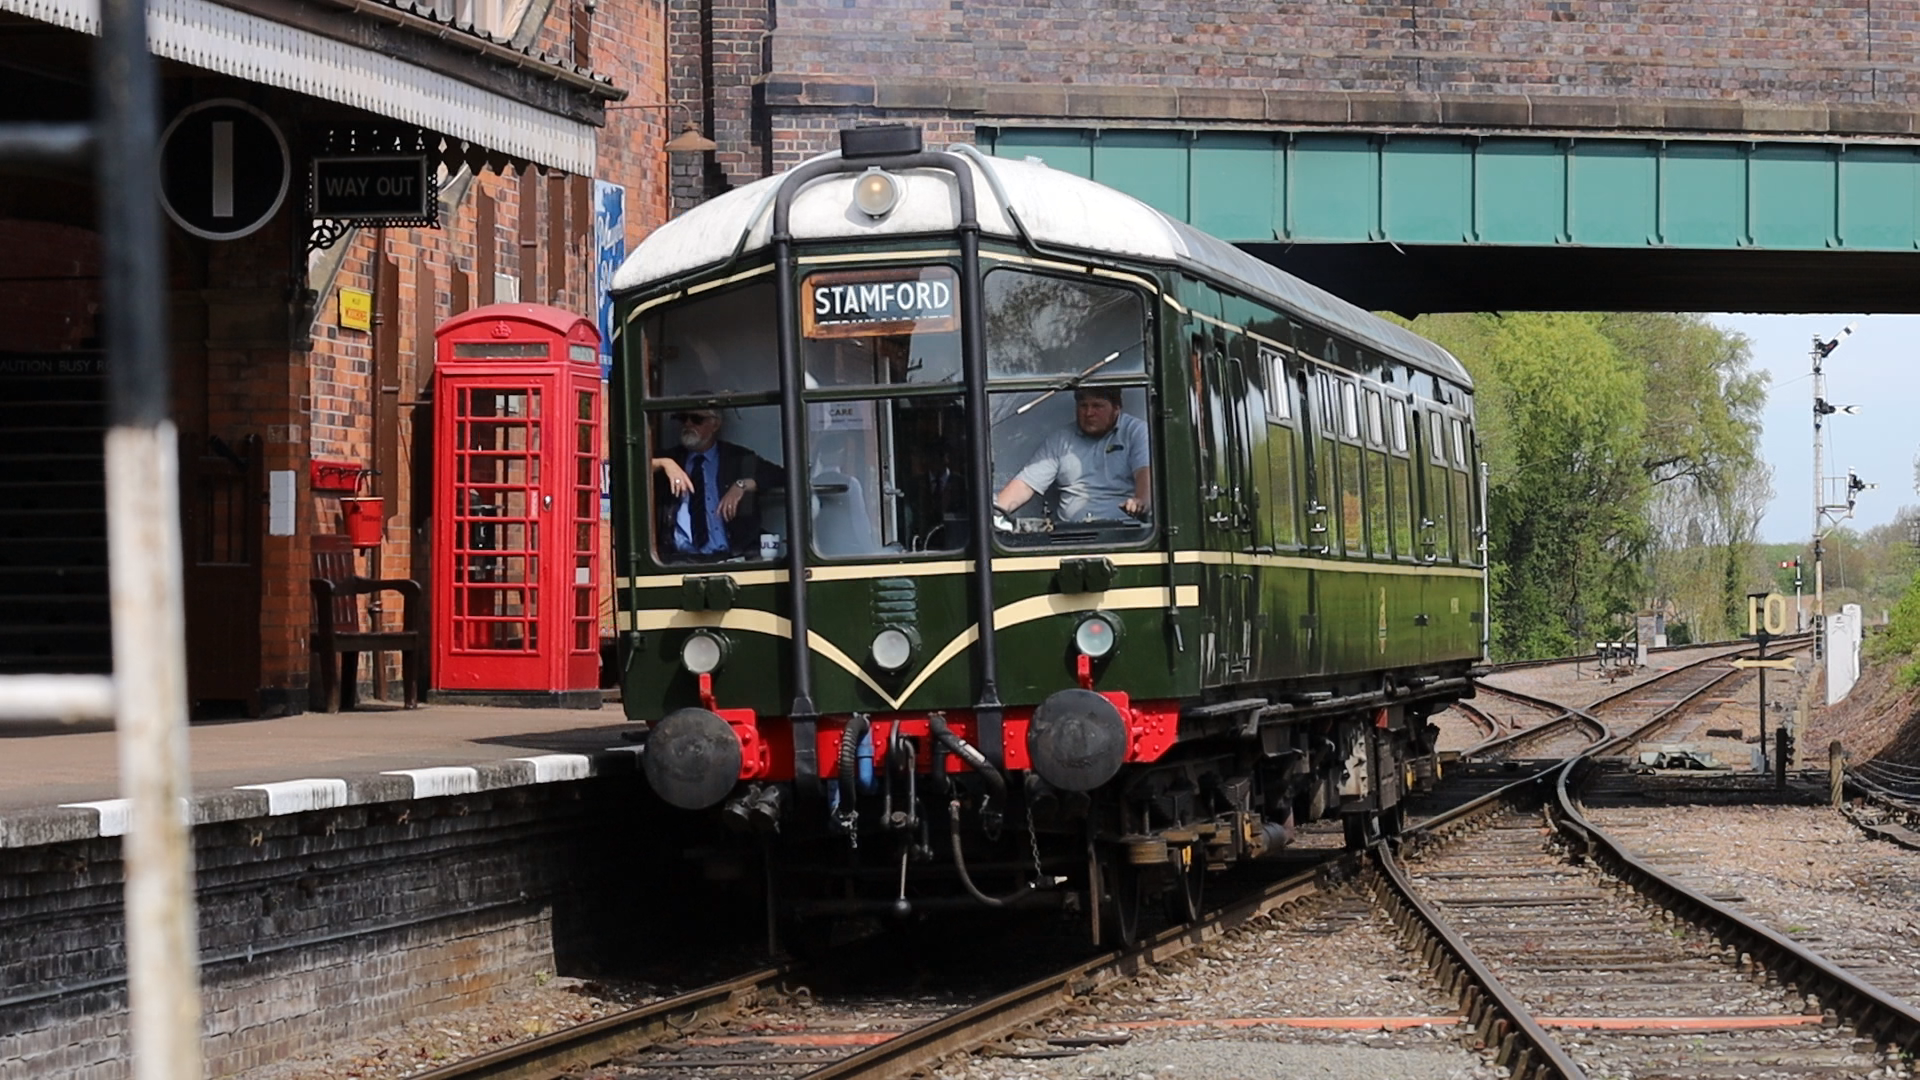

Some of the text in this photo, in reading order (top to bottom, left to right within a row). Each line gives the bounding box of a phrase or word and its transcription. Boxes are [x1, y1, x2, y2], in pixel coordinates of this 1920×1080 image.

[325, 176, 414, 196] WAY OUT
[815, 281, 949, 315] STAMFORD
[0, 360, 52, 373] AUTION
[59, 360, 91, 372] BUSY
[829, 408, 854, 417] CARE
[1749, 593, 1786, 635] 10
